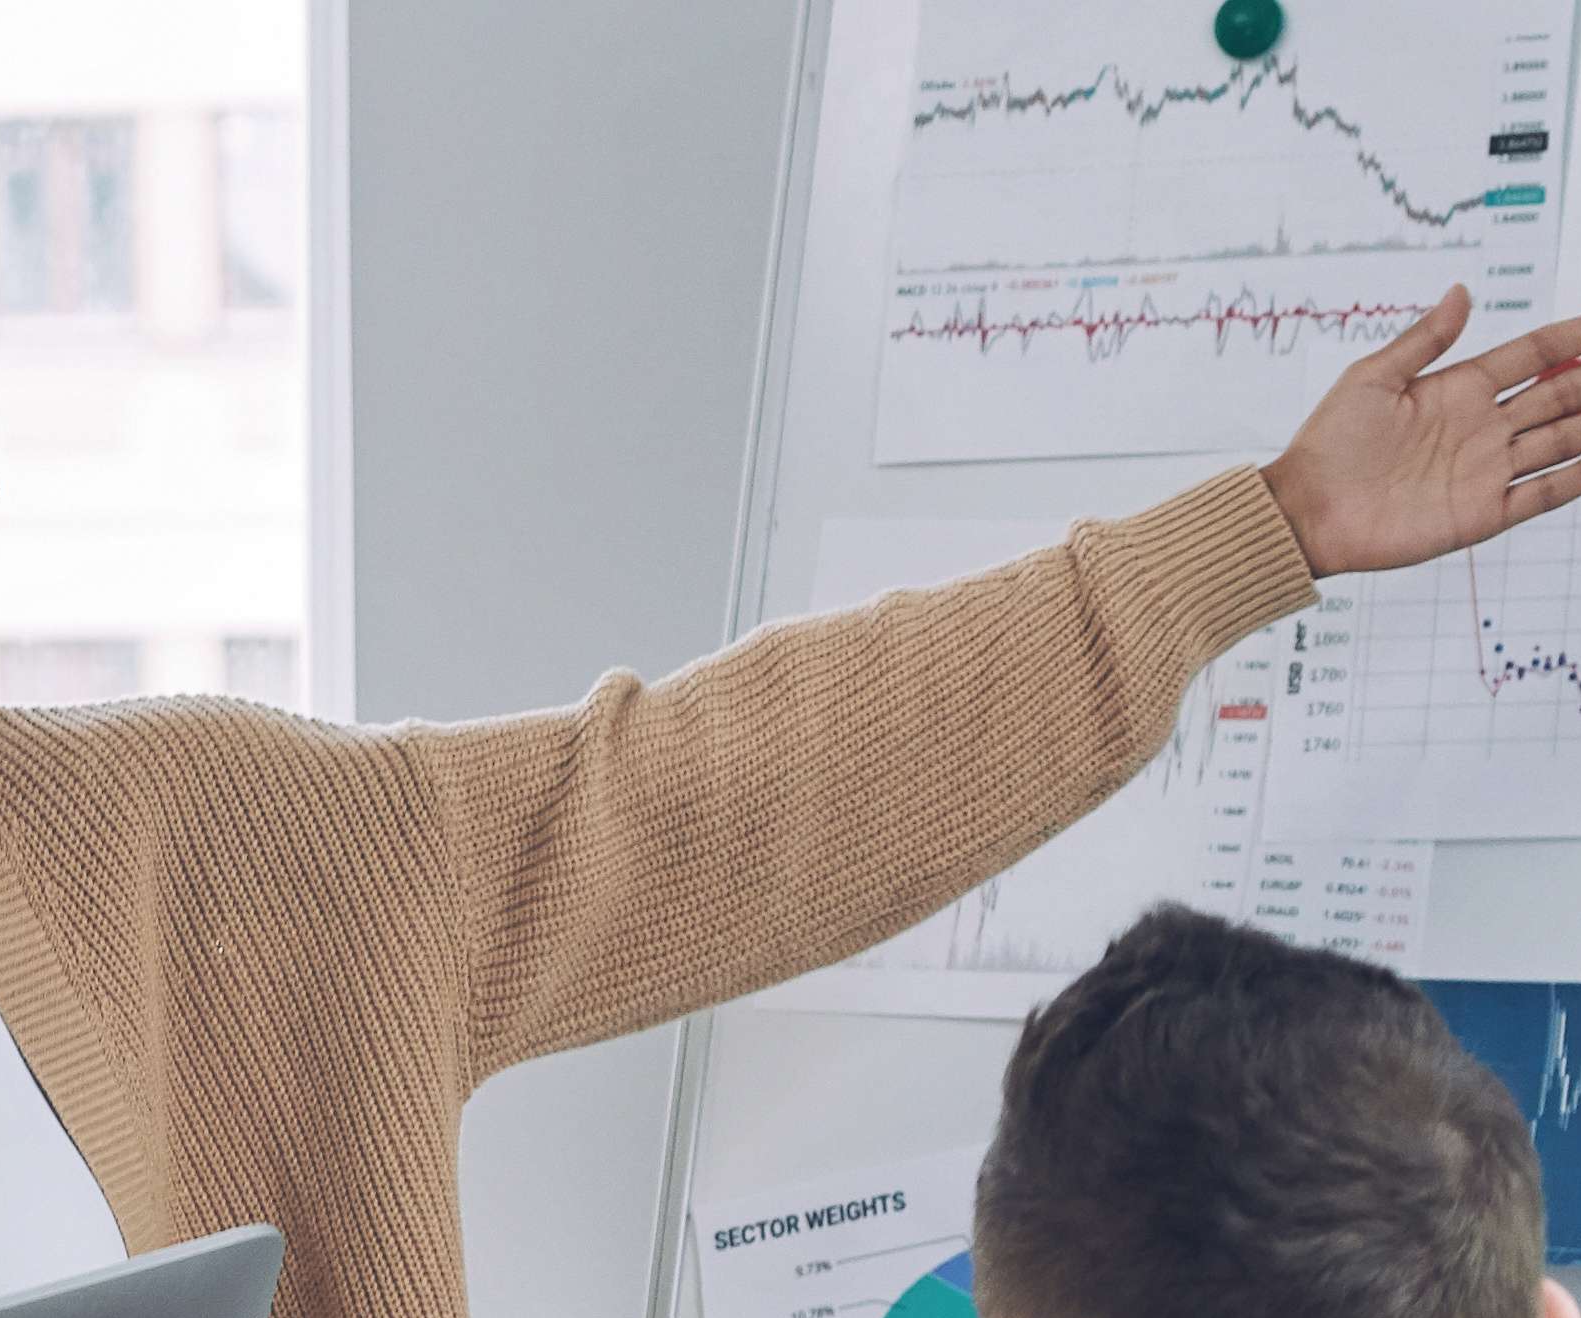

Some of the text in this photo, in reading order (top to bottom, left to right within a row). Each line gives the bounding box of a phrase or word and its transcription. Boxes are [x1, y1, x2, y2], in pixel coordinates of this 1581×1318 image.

[1287, 620, 1307, 695] USD per
[1311, 668, 1347, 682] 1780
[1307, 703, 1343, 716] 1760
[1304, 738, 1341, 752] 1740
[1256, 905, 1300, 918] EURAUD
[714, 1190, 906, 1250] SECTOR WEIGHTS
